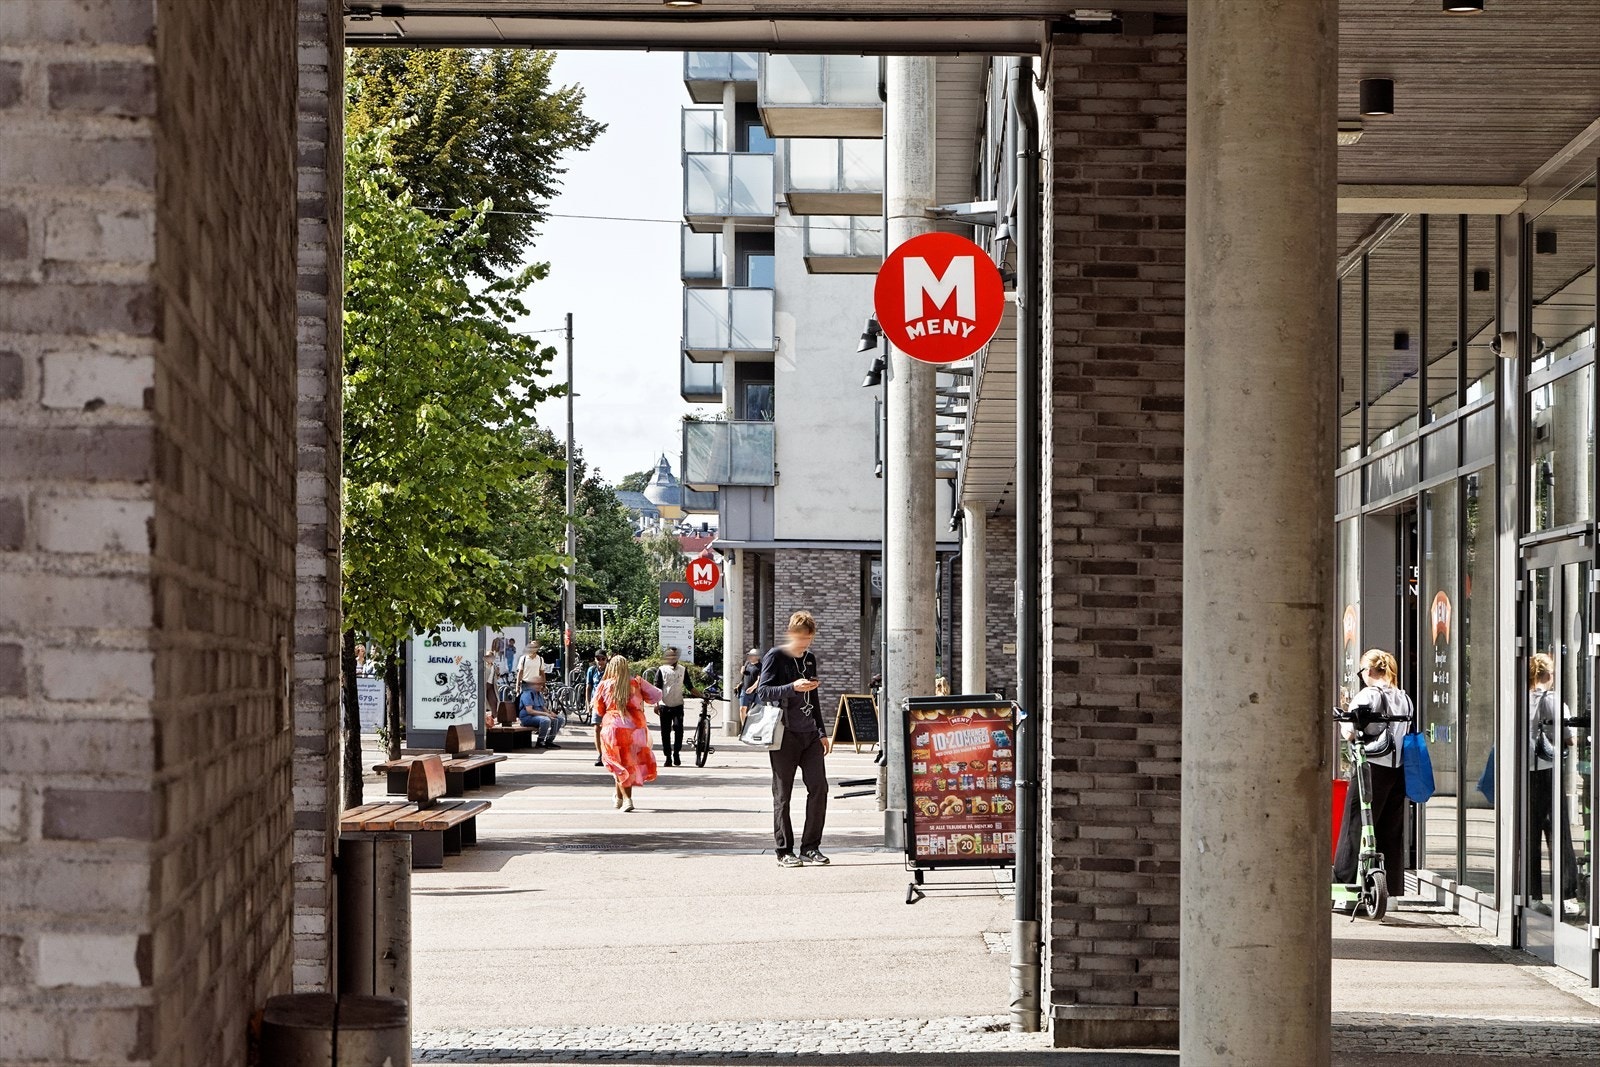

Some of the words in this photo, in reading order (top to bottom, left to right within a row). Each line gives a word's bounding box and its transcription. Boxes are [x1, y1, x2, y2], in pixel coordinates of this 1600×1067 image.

[903, 255, 976, 323] M
[905, 318, 976, 341] MENY
[693, 563, 713, 581] M
[434, 711, 456, 719] SATS
[961, 841, 973, 850] 20
